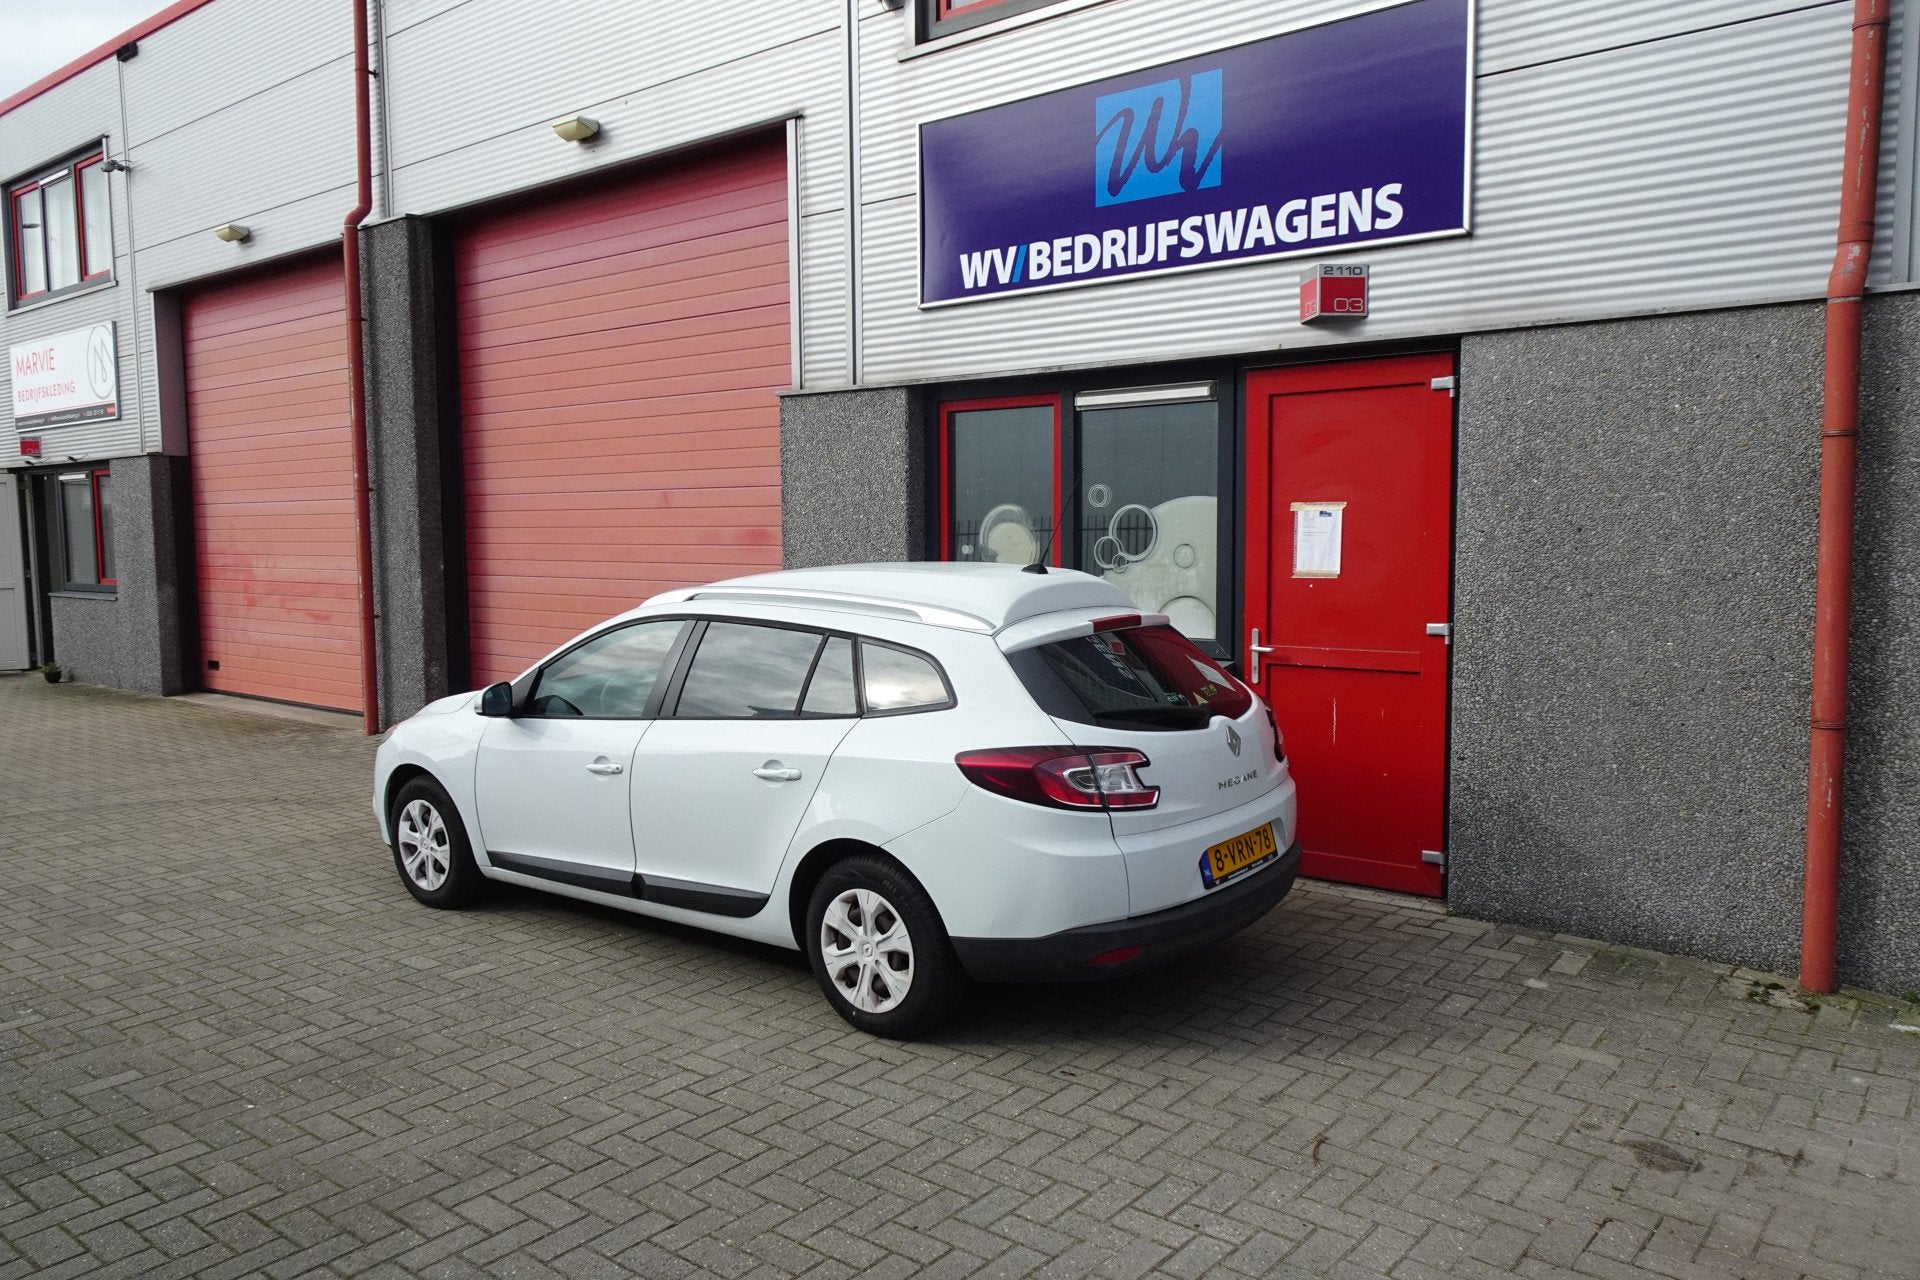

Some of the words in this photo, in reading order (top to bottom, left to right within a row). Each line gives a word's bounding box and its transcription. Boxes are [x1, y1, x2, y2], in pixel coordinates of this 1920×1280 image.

[1323, 265, 1363, 276] 2110
[1333, 297, 1364, 312] 03
[16, 348, 55, 378] MARVIE
[18, 380, 76, 403] BEDRIJFSKLEDING
[1218, 769, 1258, 790] MEGANE
[1214, 828, 1271, 872] 8-VRN-78
